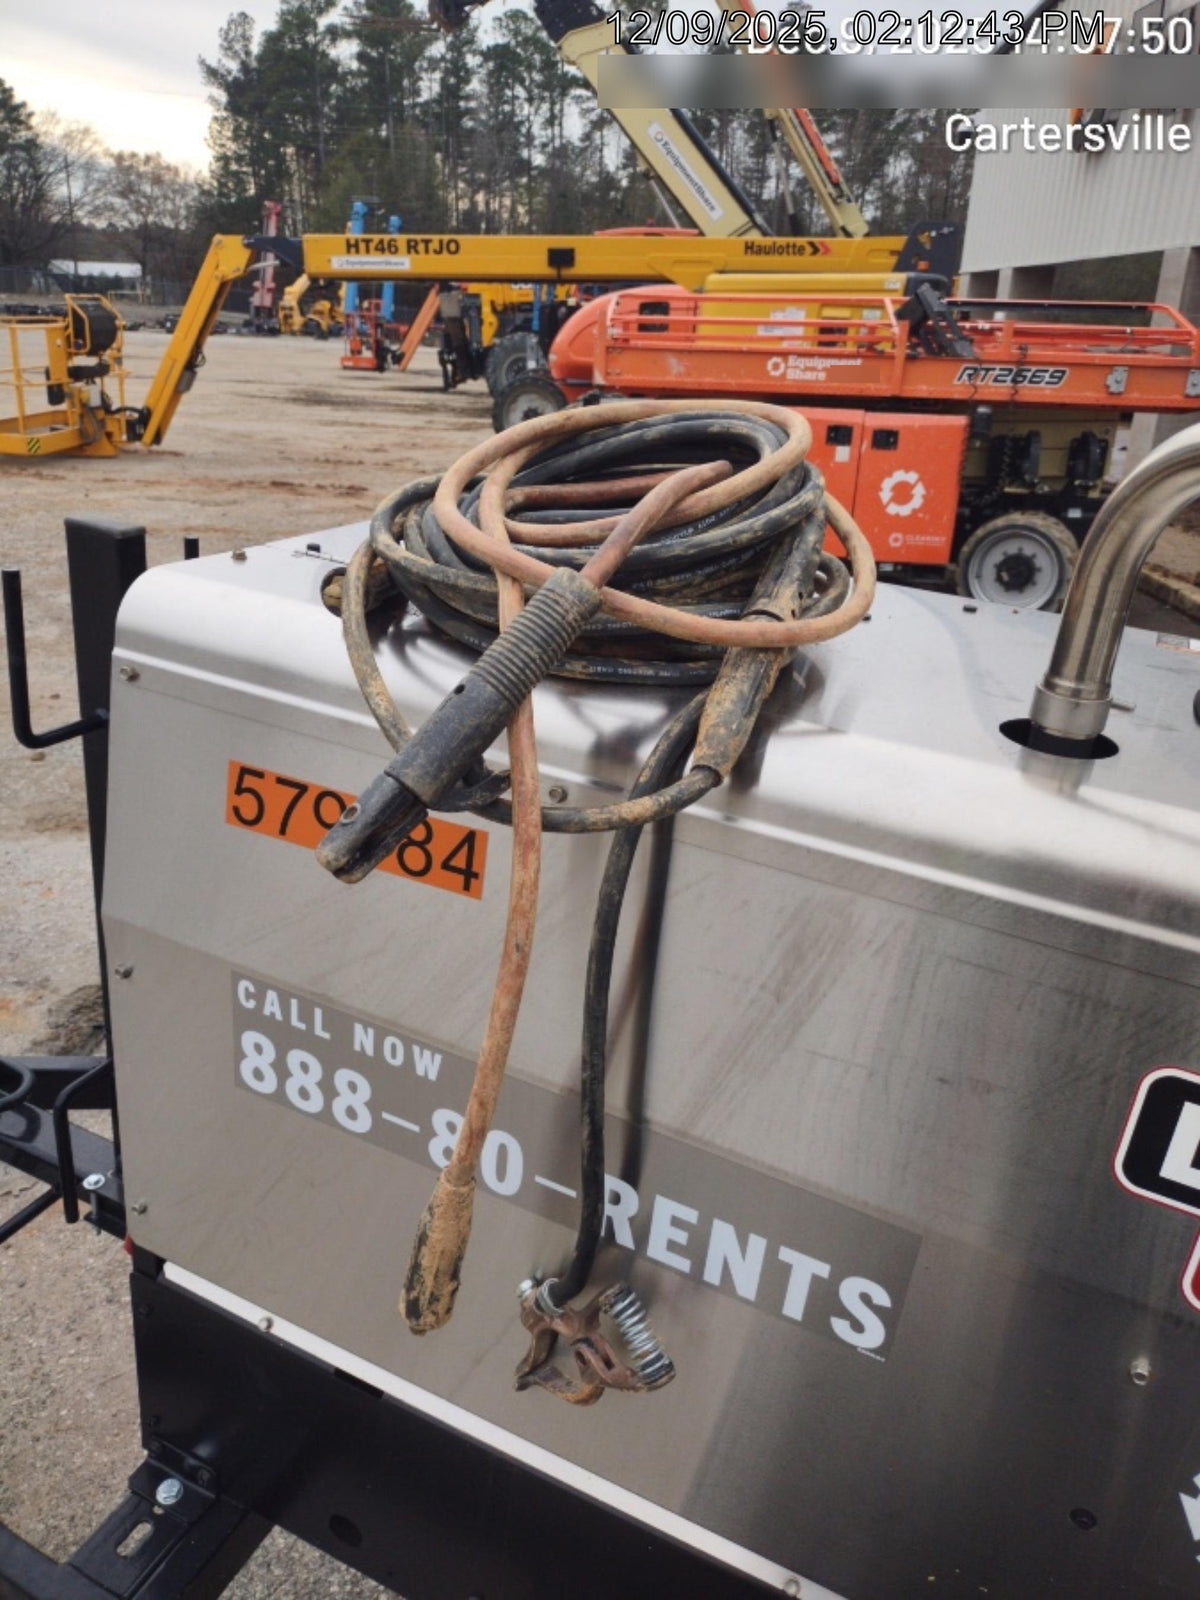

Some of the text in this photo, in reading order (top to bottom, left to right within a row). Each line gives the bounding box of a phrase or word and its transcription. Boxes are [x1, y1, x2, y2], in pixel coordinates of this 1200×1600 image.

[345, 238, 461, 255] HT46 RTJO
[744, 241, 806, 256] Haulotte
[786, 368, 826, 381] Share
[954, 364, 1069, 388] RT2669
[232, 766, 479, 892] 57984
[237, 979, 443, 1082] CALL NOW
